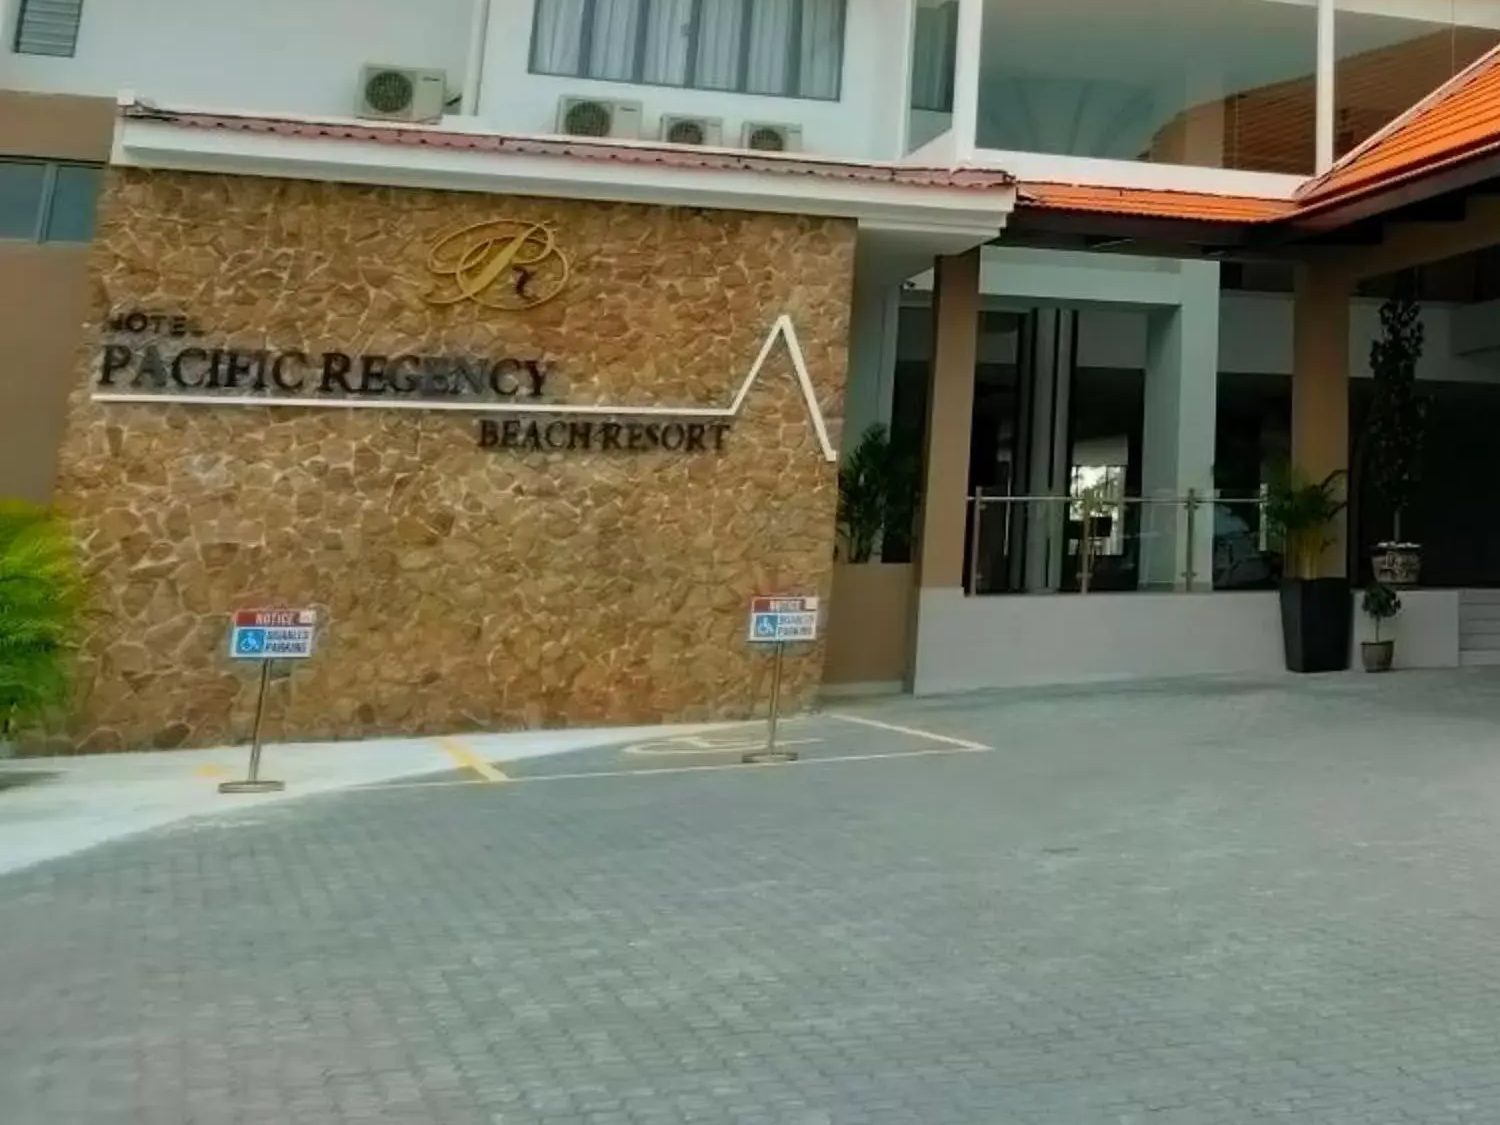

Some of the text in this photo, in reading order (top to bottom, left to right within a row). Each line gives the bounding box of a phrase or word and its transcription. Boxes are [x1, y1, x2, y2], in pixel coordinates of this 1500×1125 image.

[97, 343, 557, 397] PACIFIC REGENCY
[477, 418, 731, 453] BEACH RESORT
